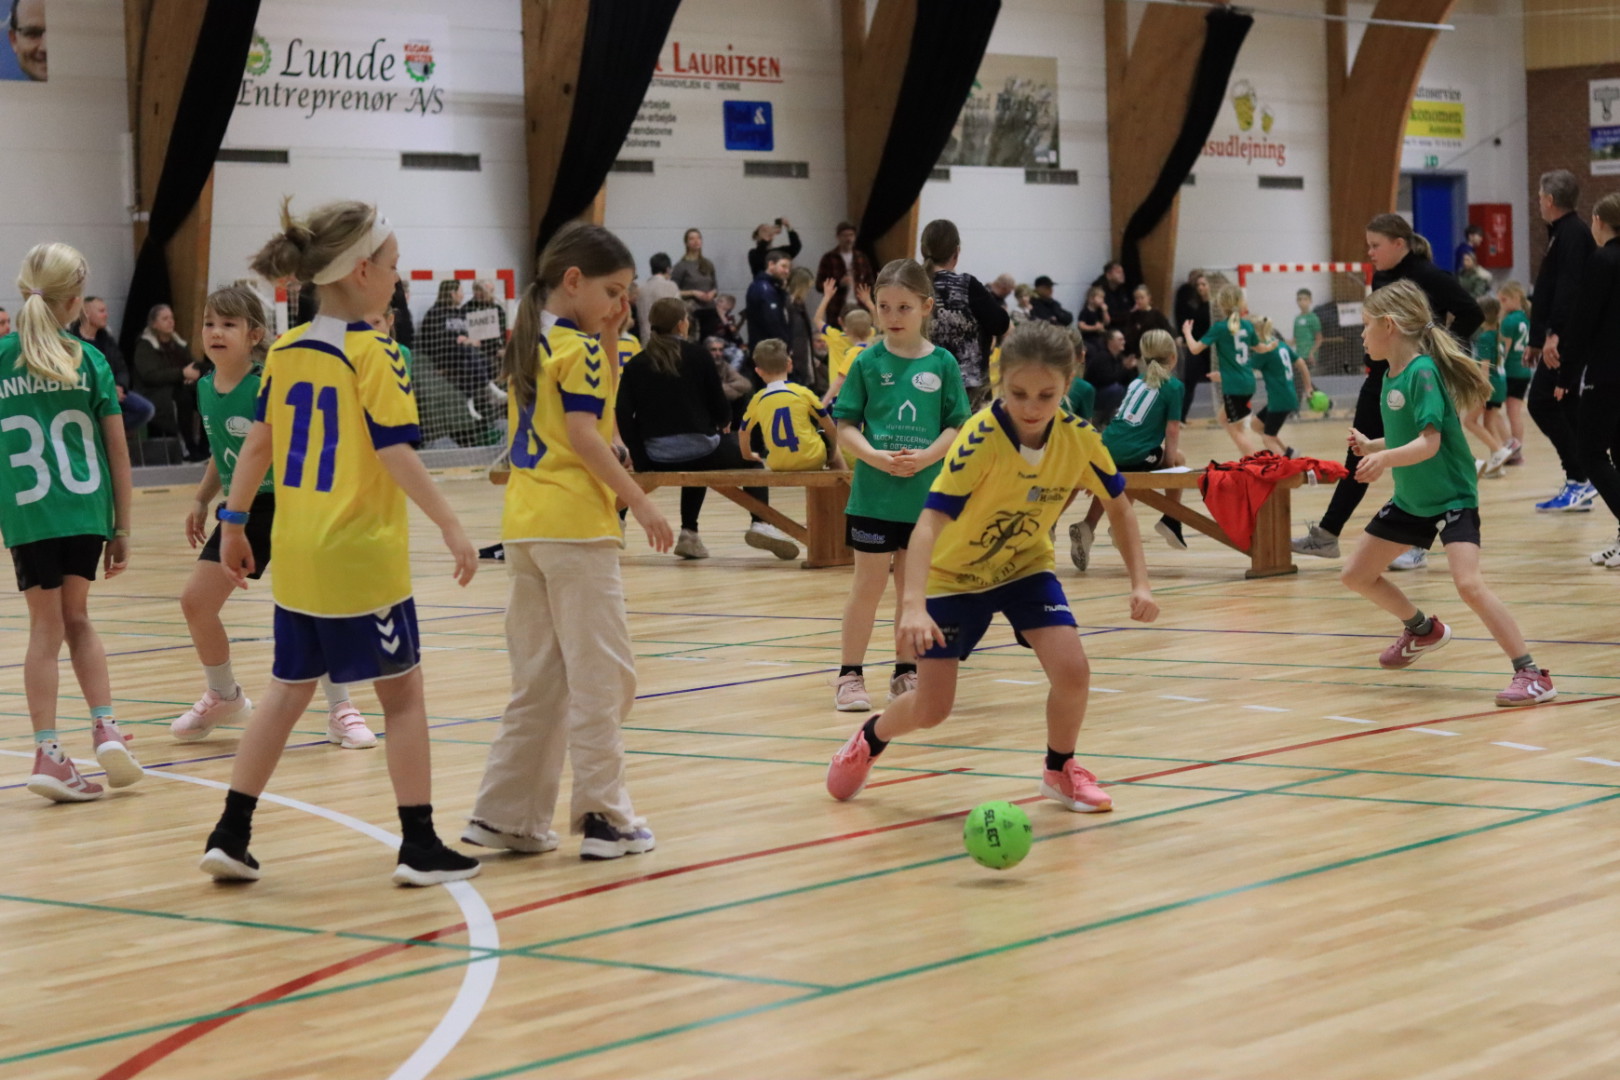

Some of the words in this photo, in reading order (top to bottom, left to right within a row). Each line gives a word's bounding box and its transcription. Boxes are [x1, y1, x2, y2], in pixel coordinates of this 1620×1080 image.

[280, 38, 395, 81] Lunde
[238, 79, 397, 118] Entreprenør
[1234, 329, 1249, 366] 5
[1279, 347, 1294, 382] 9
[283, 381, 339, 493] 11
[772, 406, 800, 453] 4
[1, 409, 101, 506] 30
[984, 809, 1001, 848] SELECT
